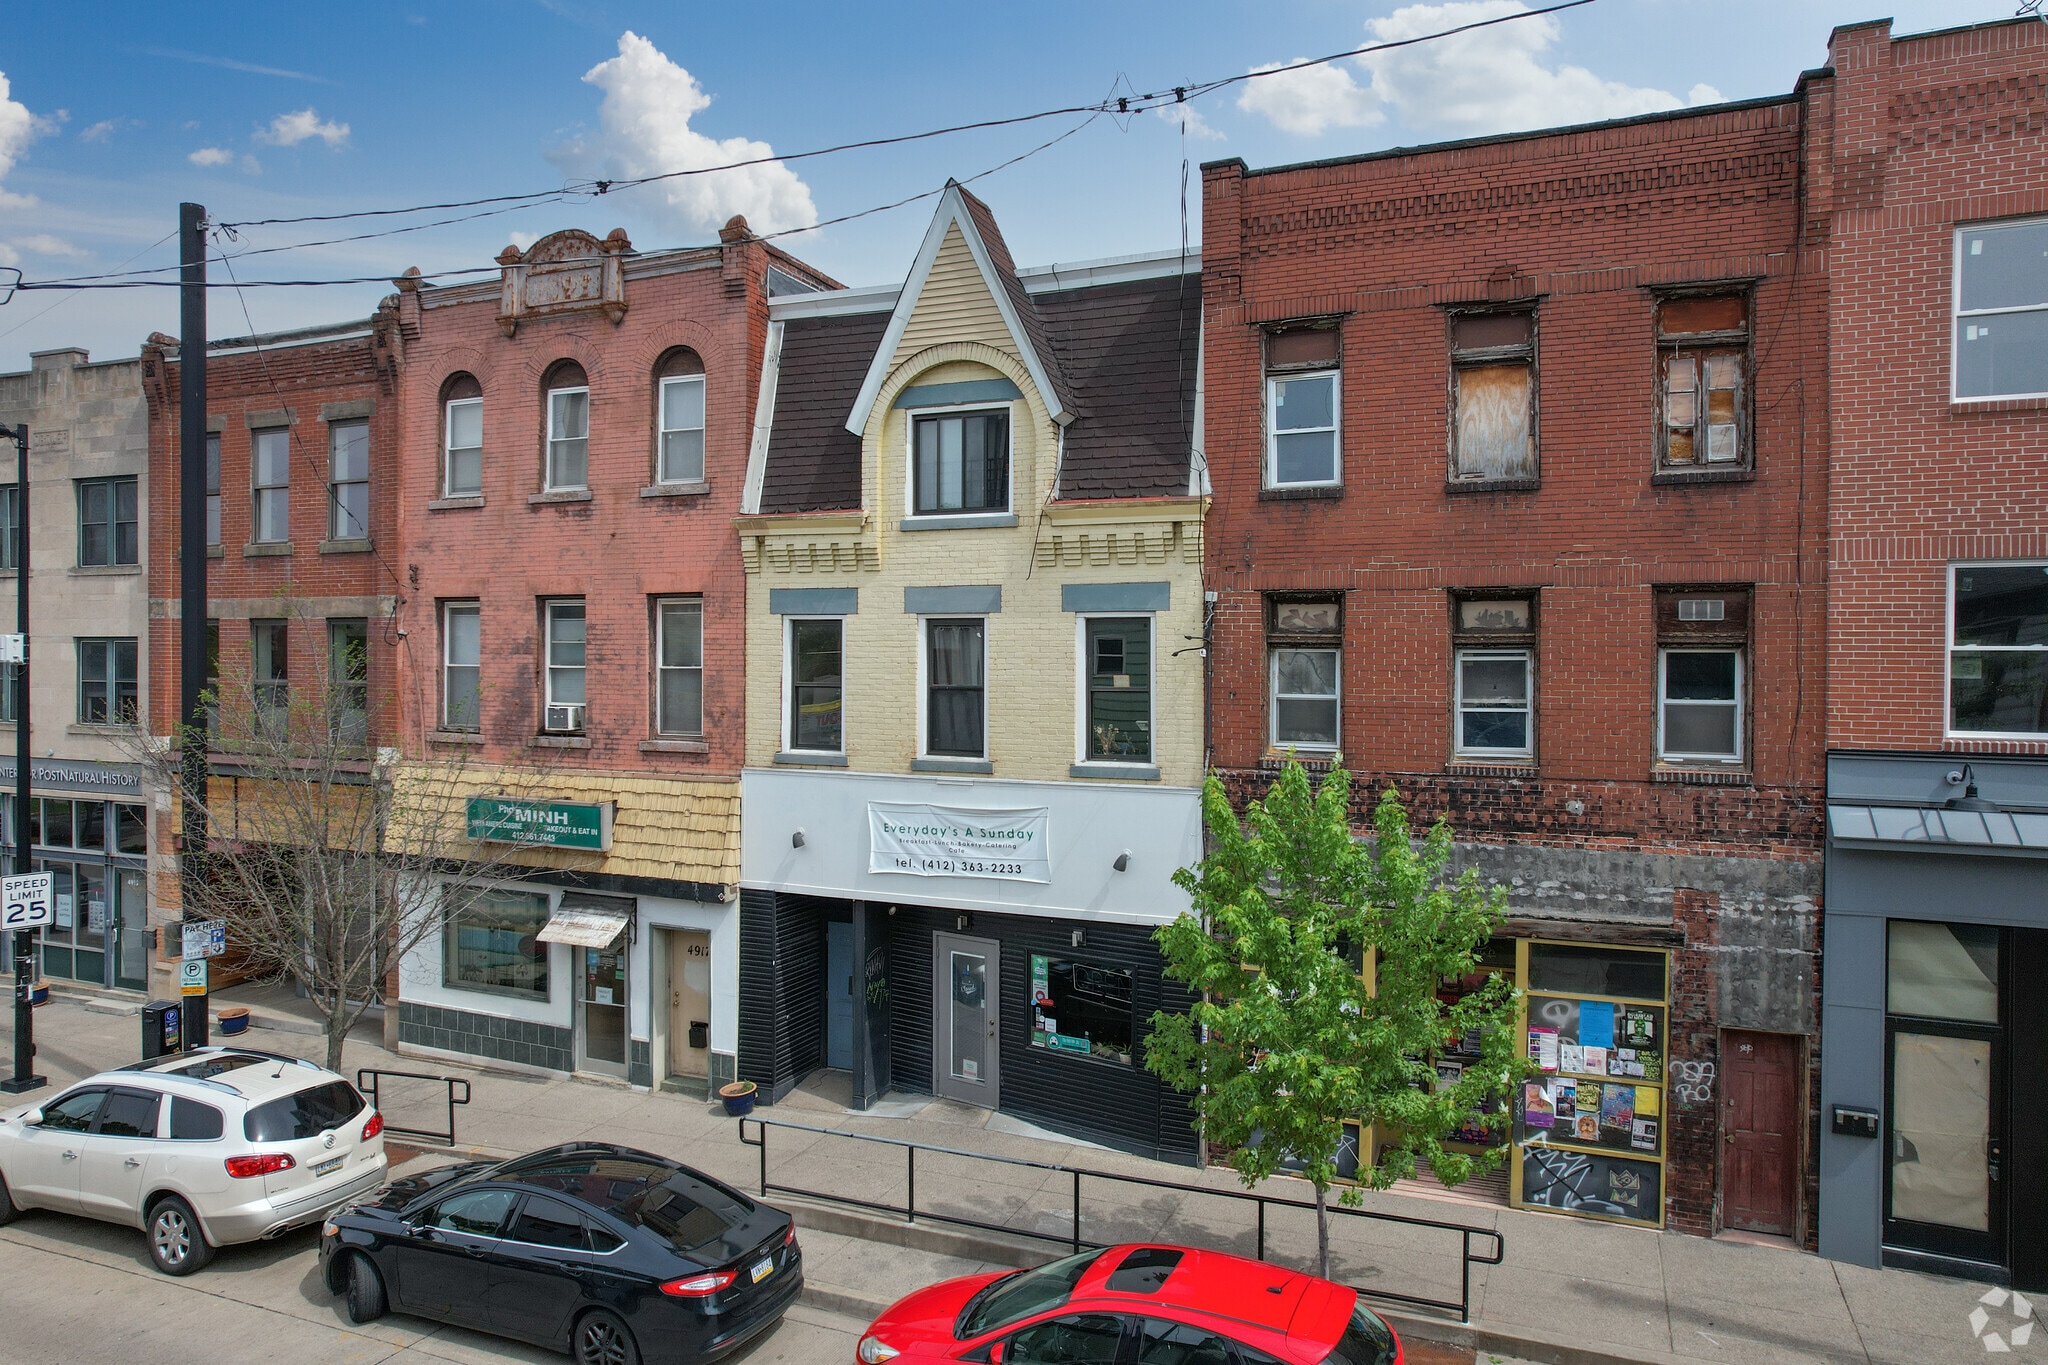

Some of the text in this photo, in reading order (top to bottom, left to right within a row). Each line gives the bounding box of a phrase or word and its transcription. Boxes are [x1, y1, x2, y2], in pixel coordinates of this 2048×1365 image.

[0, 766, 17, 777] NTER
[515, 809, 568, 825] MINH
[578, 827, 590, 835] EAT
[591, 828, 598, 836] IN
[883, 822, 1034, 841] Everyday's A Sunday
[895, 858, 1022, 874] tel. (412) 363-2233
[5, 878, 48, 891] SPEED
[10, 889, 43, 902] LIMIT
[7, 900, 47, 924] 25
